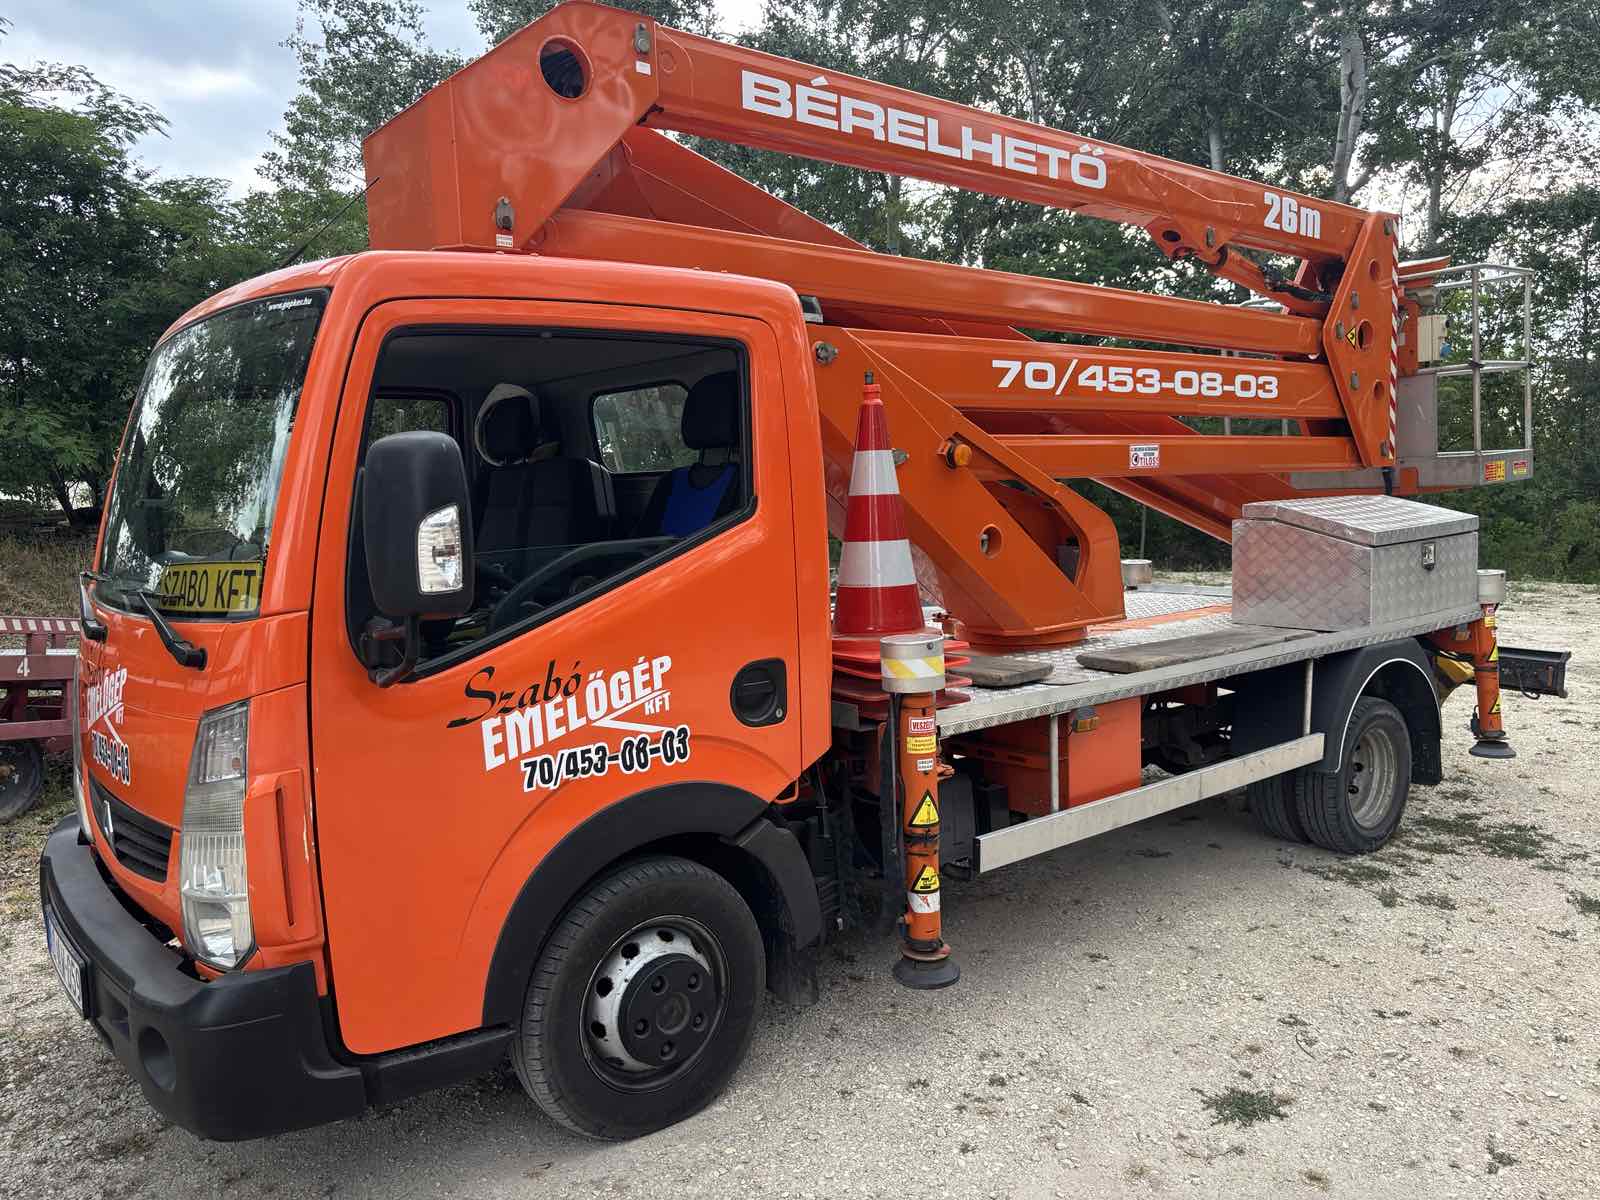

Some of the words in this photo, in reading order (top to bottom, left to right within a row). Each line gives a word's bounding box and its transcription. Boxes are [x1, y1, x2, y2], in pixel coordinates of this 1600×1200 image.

[741, 70, 1107, 190] BÉRELHETŐ
[992, 358, 1279, 399] 70/453-08-03
[214, 569, 257, 609] KFT
[16, 656, 31, 677] 4
[447, 659, 582, 729] Szabó
[481, 655, 672, 772] EMELŐGÉP
[644, 693, 671, 716] KFT
[521, 725, 691, 792] 70/453-08-03
